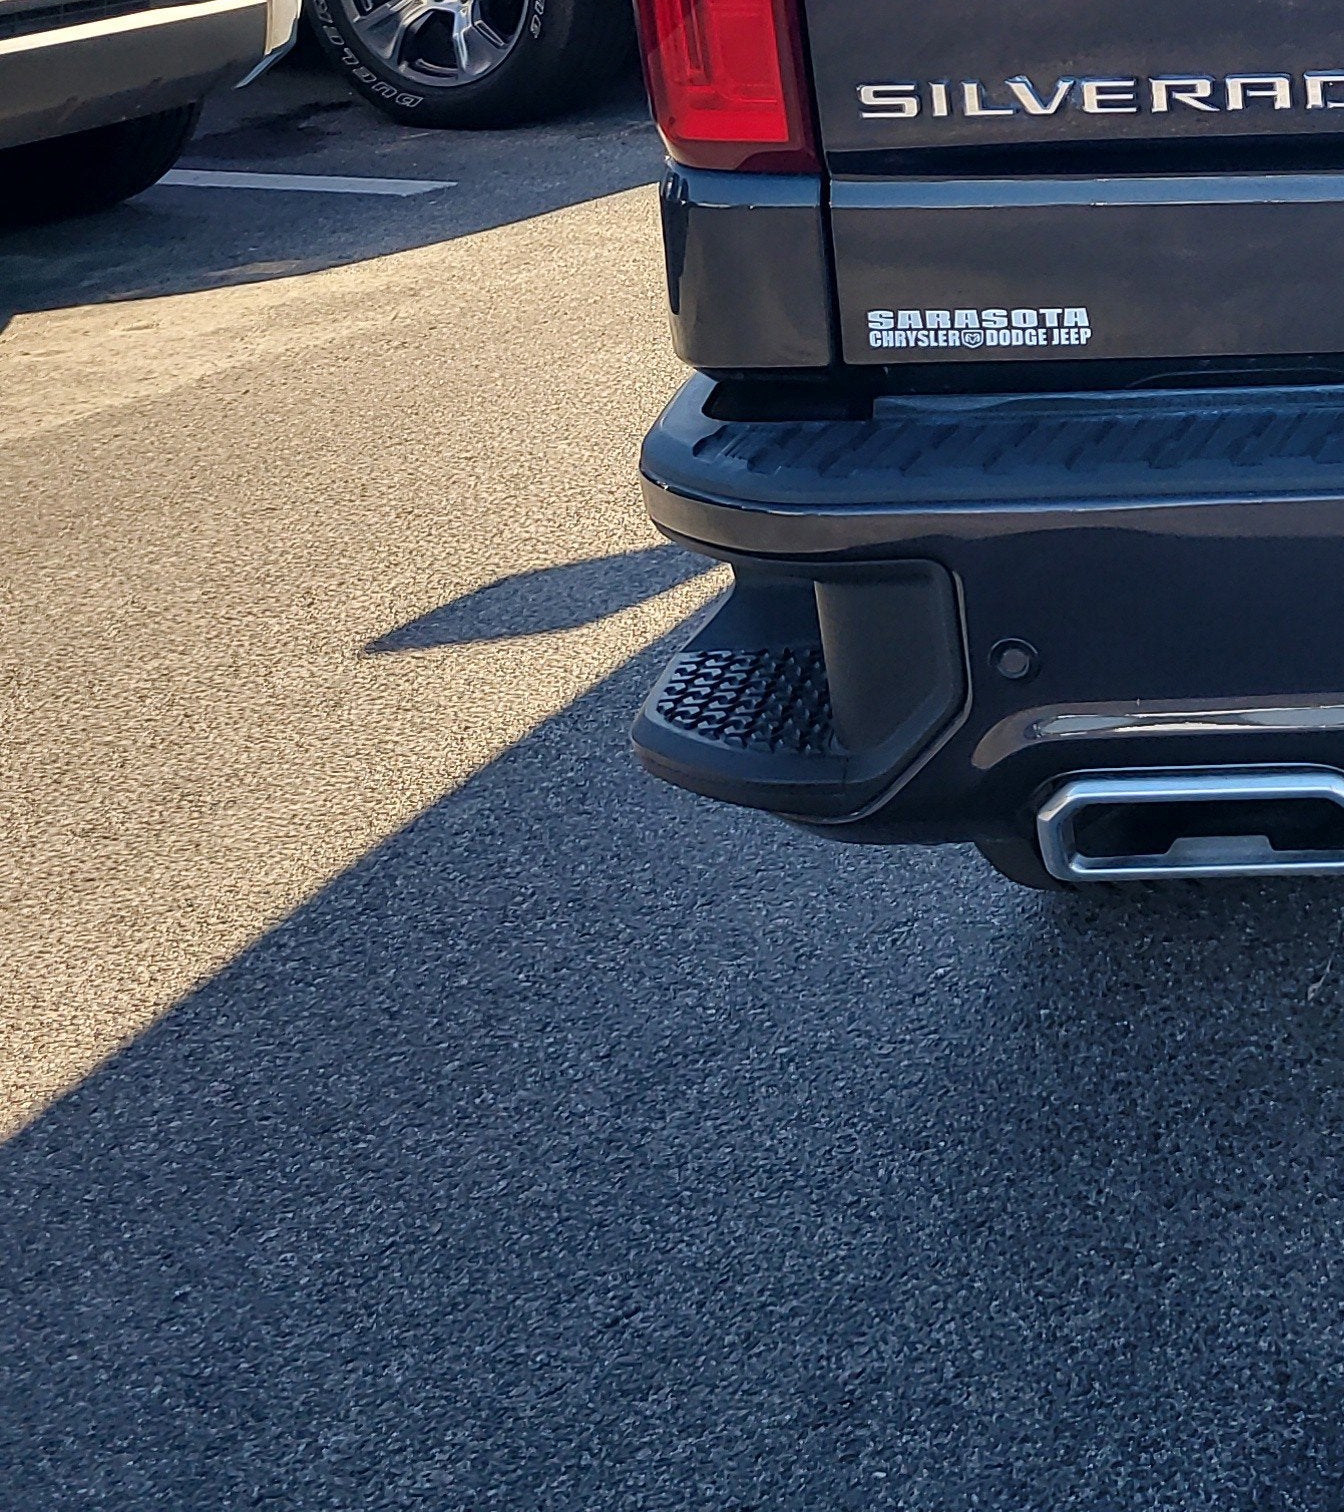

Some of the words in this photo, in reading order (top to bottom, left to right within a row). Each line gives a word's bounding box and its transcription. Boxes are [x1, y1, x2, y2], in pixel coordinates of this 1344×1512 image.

[867, 307, 1090, 330] SARASOTA
[868, 329, 962, 348] CHRYSLER
[985, 328, 1049, 346] DODGE
[1051, 327, 1092, 345] JEEP
